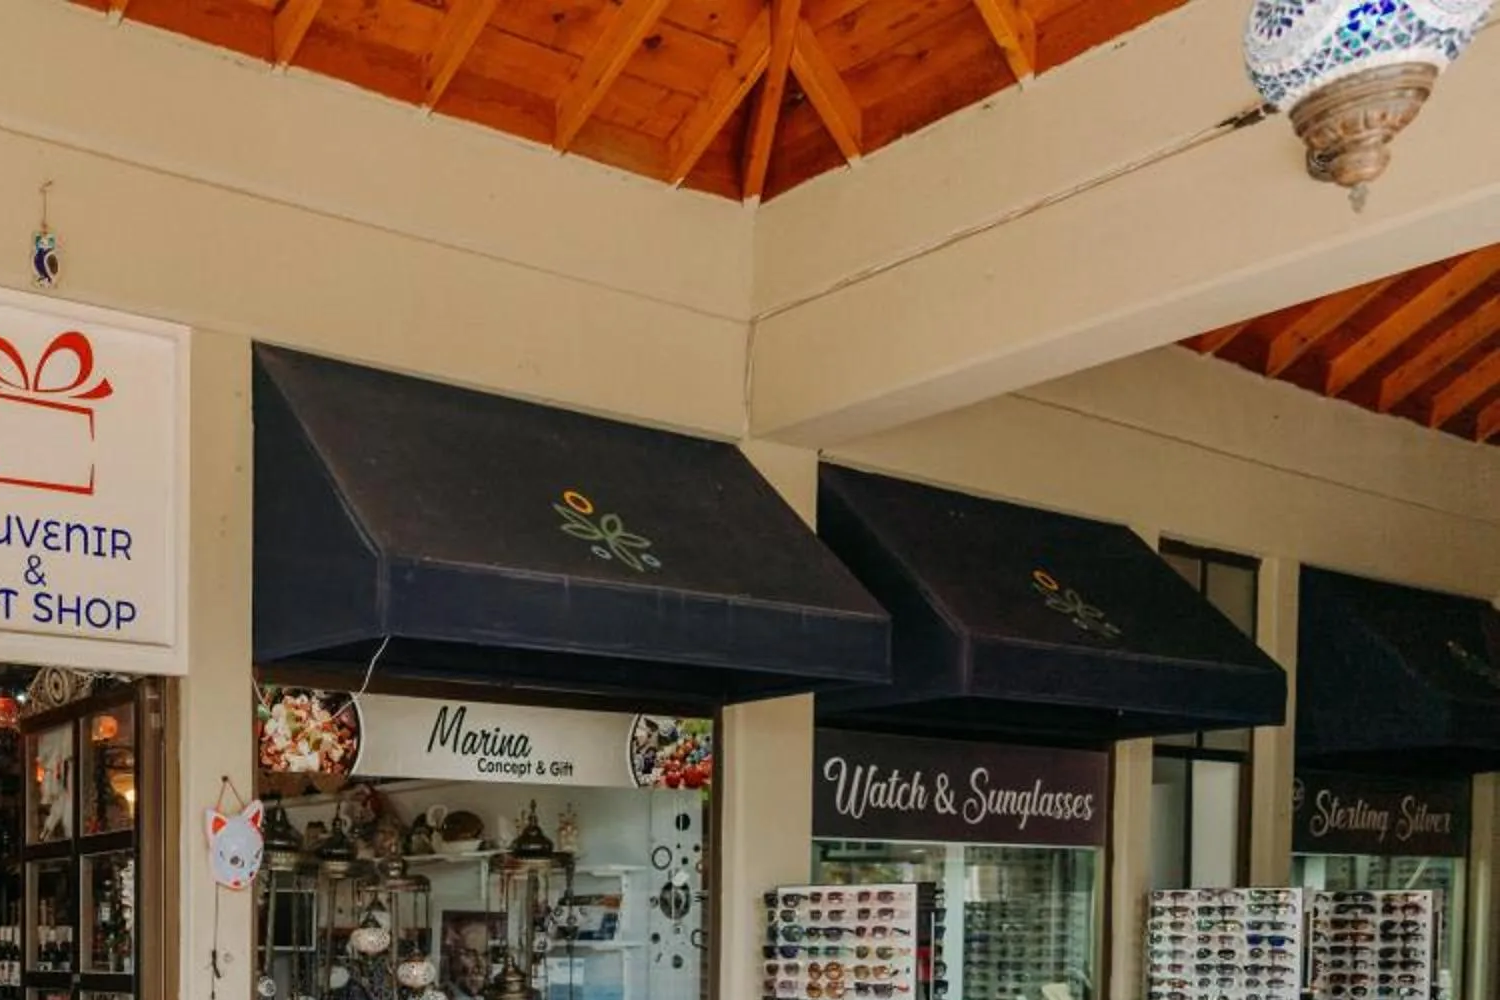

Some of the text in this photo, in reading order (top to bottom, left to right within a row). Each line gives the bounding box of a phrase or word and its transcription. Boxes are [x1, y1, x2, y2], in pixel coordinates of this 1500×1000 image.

[23, 554, 47, 587] &
[32, 592, 136, 631] SHOP
[426, 705, 532, 758] Marina
[477, 757, 574, 777] Concept & Gift
[823, 756, 1094, 830] Watch & Sunglasses
[1310, 789, 1452, 844] Sterling Silver
